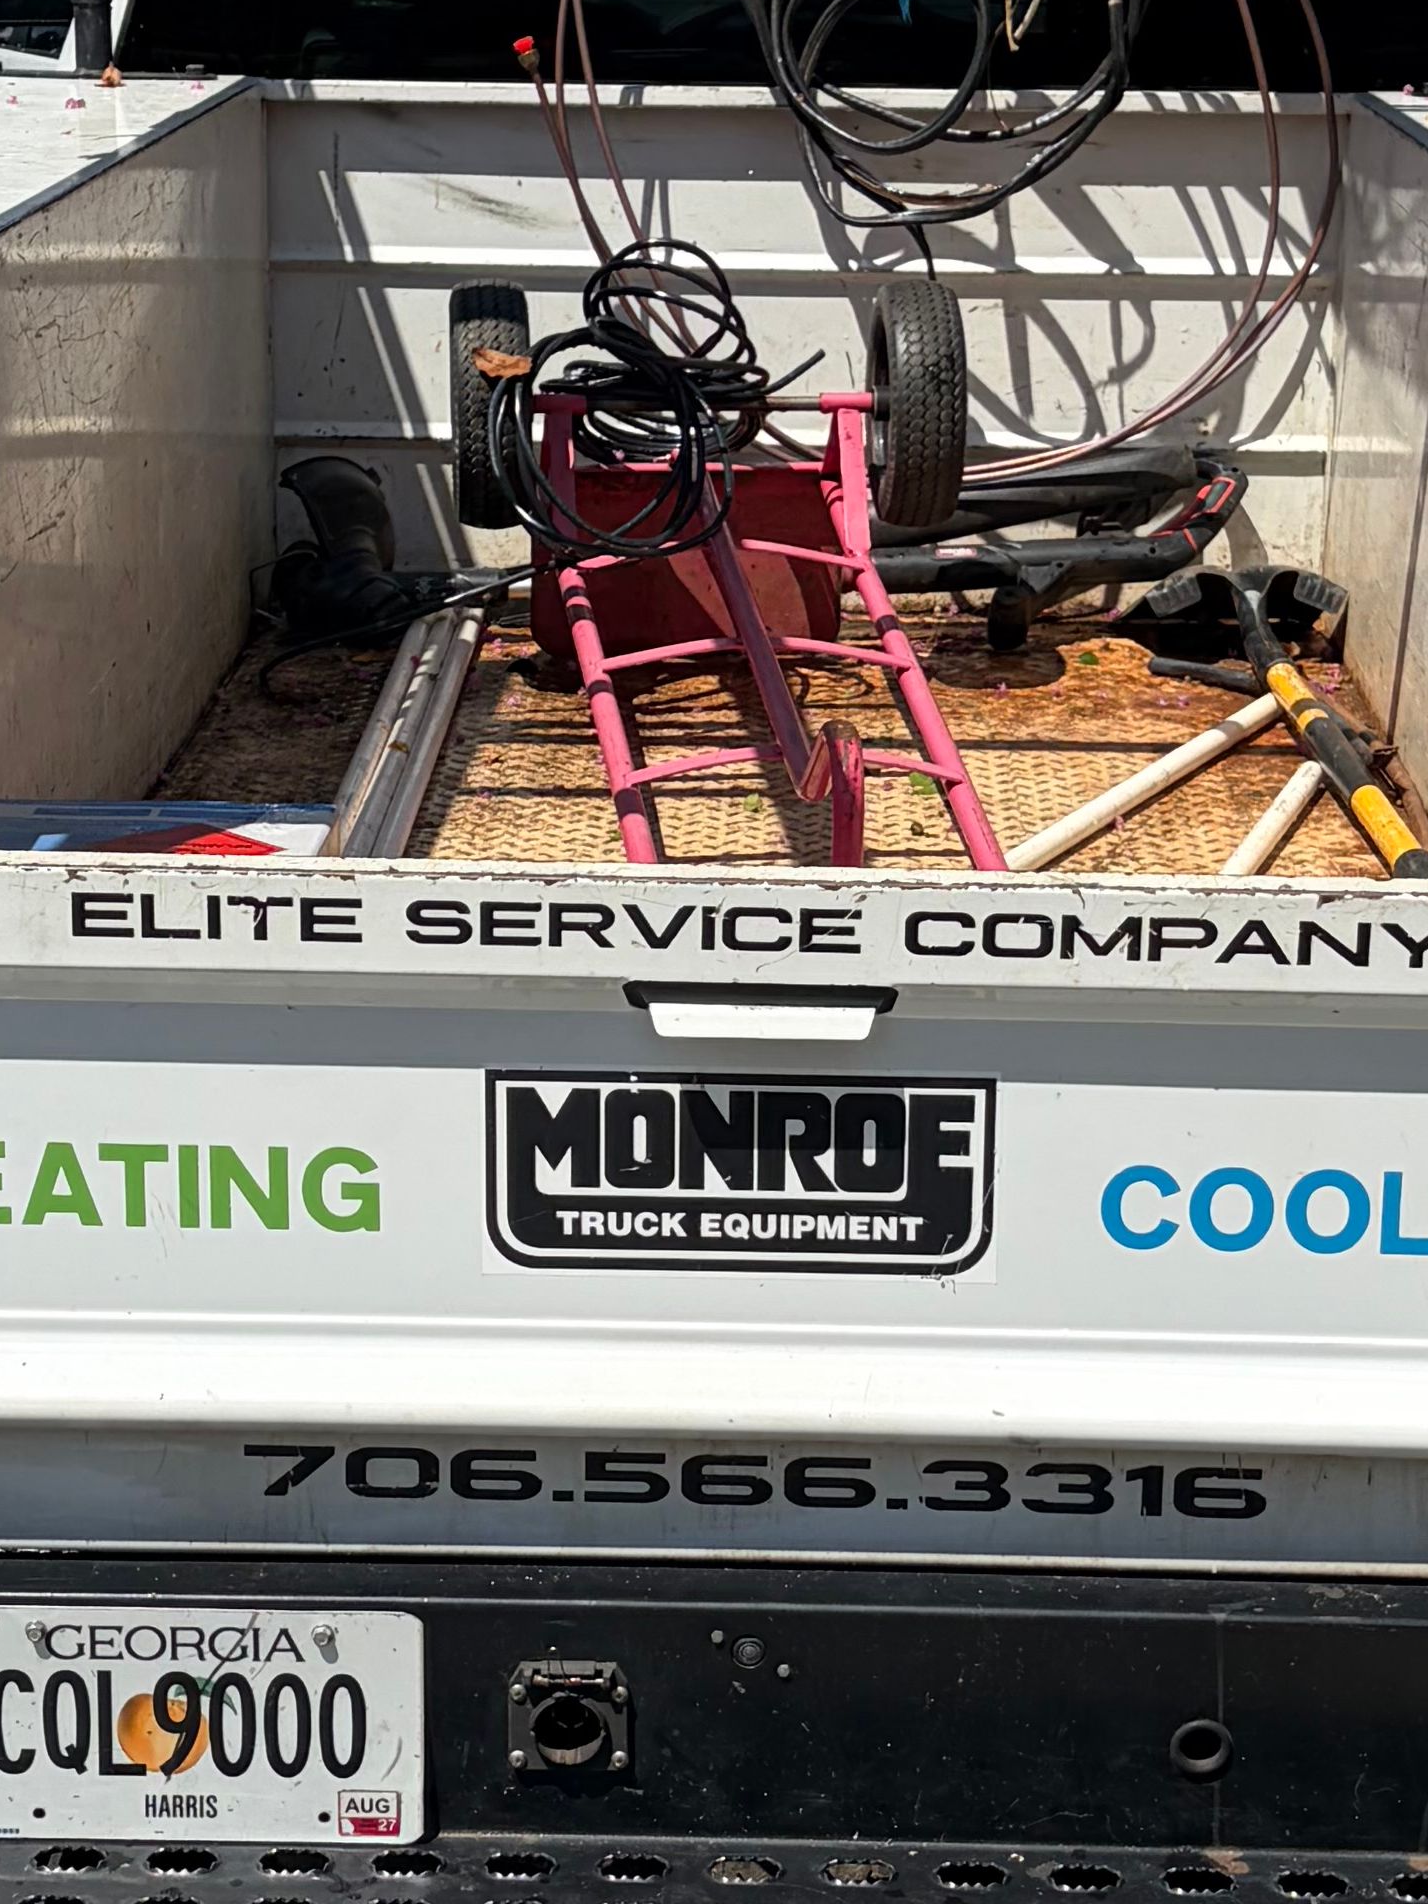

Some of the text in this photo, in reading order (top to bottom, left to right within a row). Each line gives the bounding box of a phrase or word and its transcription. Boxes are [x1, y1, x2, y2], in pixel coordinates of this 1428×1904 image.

[72, 892, 363, 943] ELITE
[405, 899, 862, 954] SERVICE
[506, 1087, 975, 1194] MONROE
[556, 1210, 923, 1242] TRUCK EQUIPMENT
[243, 1444, 1268, 1520] 706.566.3316
[45, 1624, 305, 1663] GEORGIA
[144, 1794, 218, 1819] HARRIS
[344, 1797, 391, 1814] AUG
[377, 1819, 397, 1833] 27
